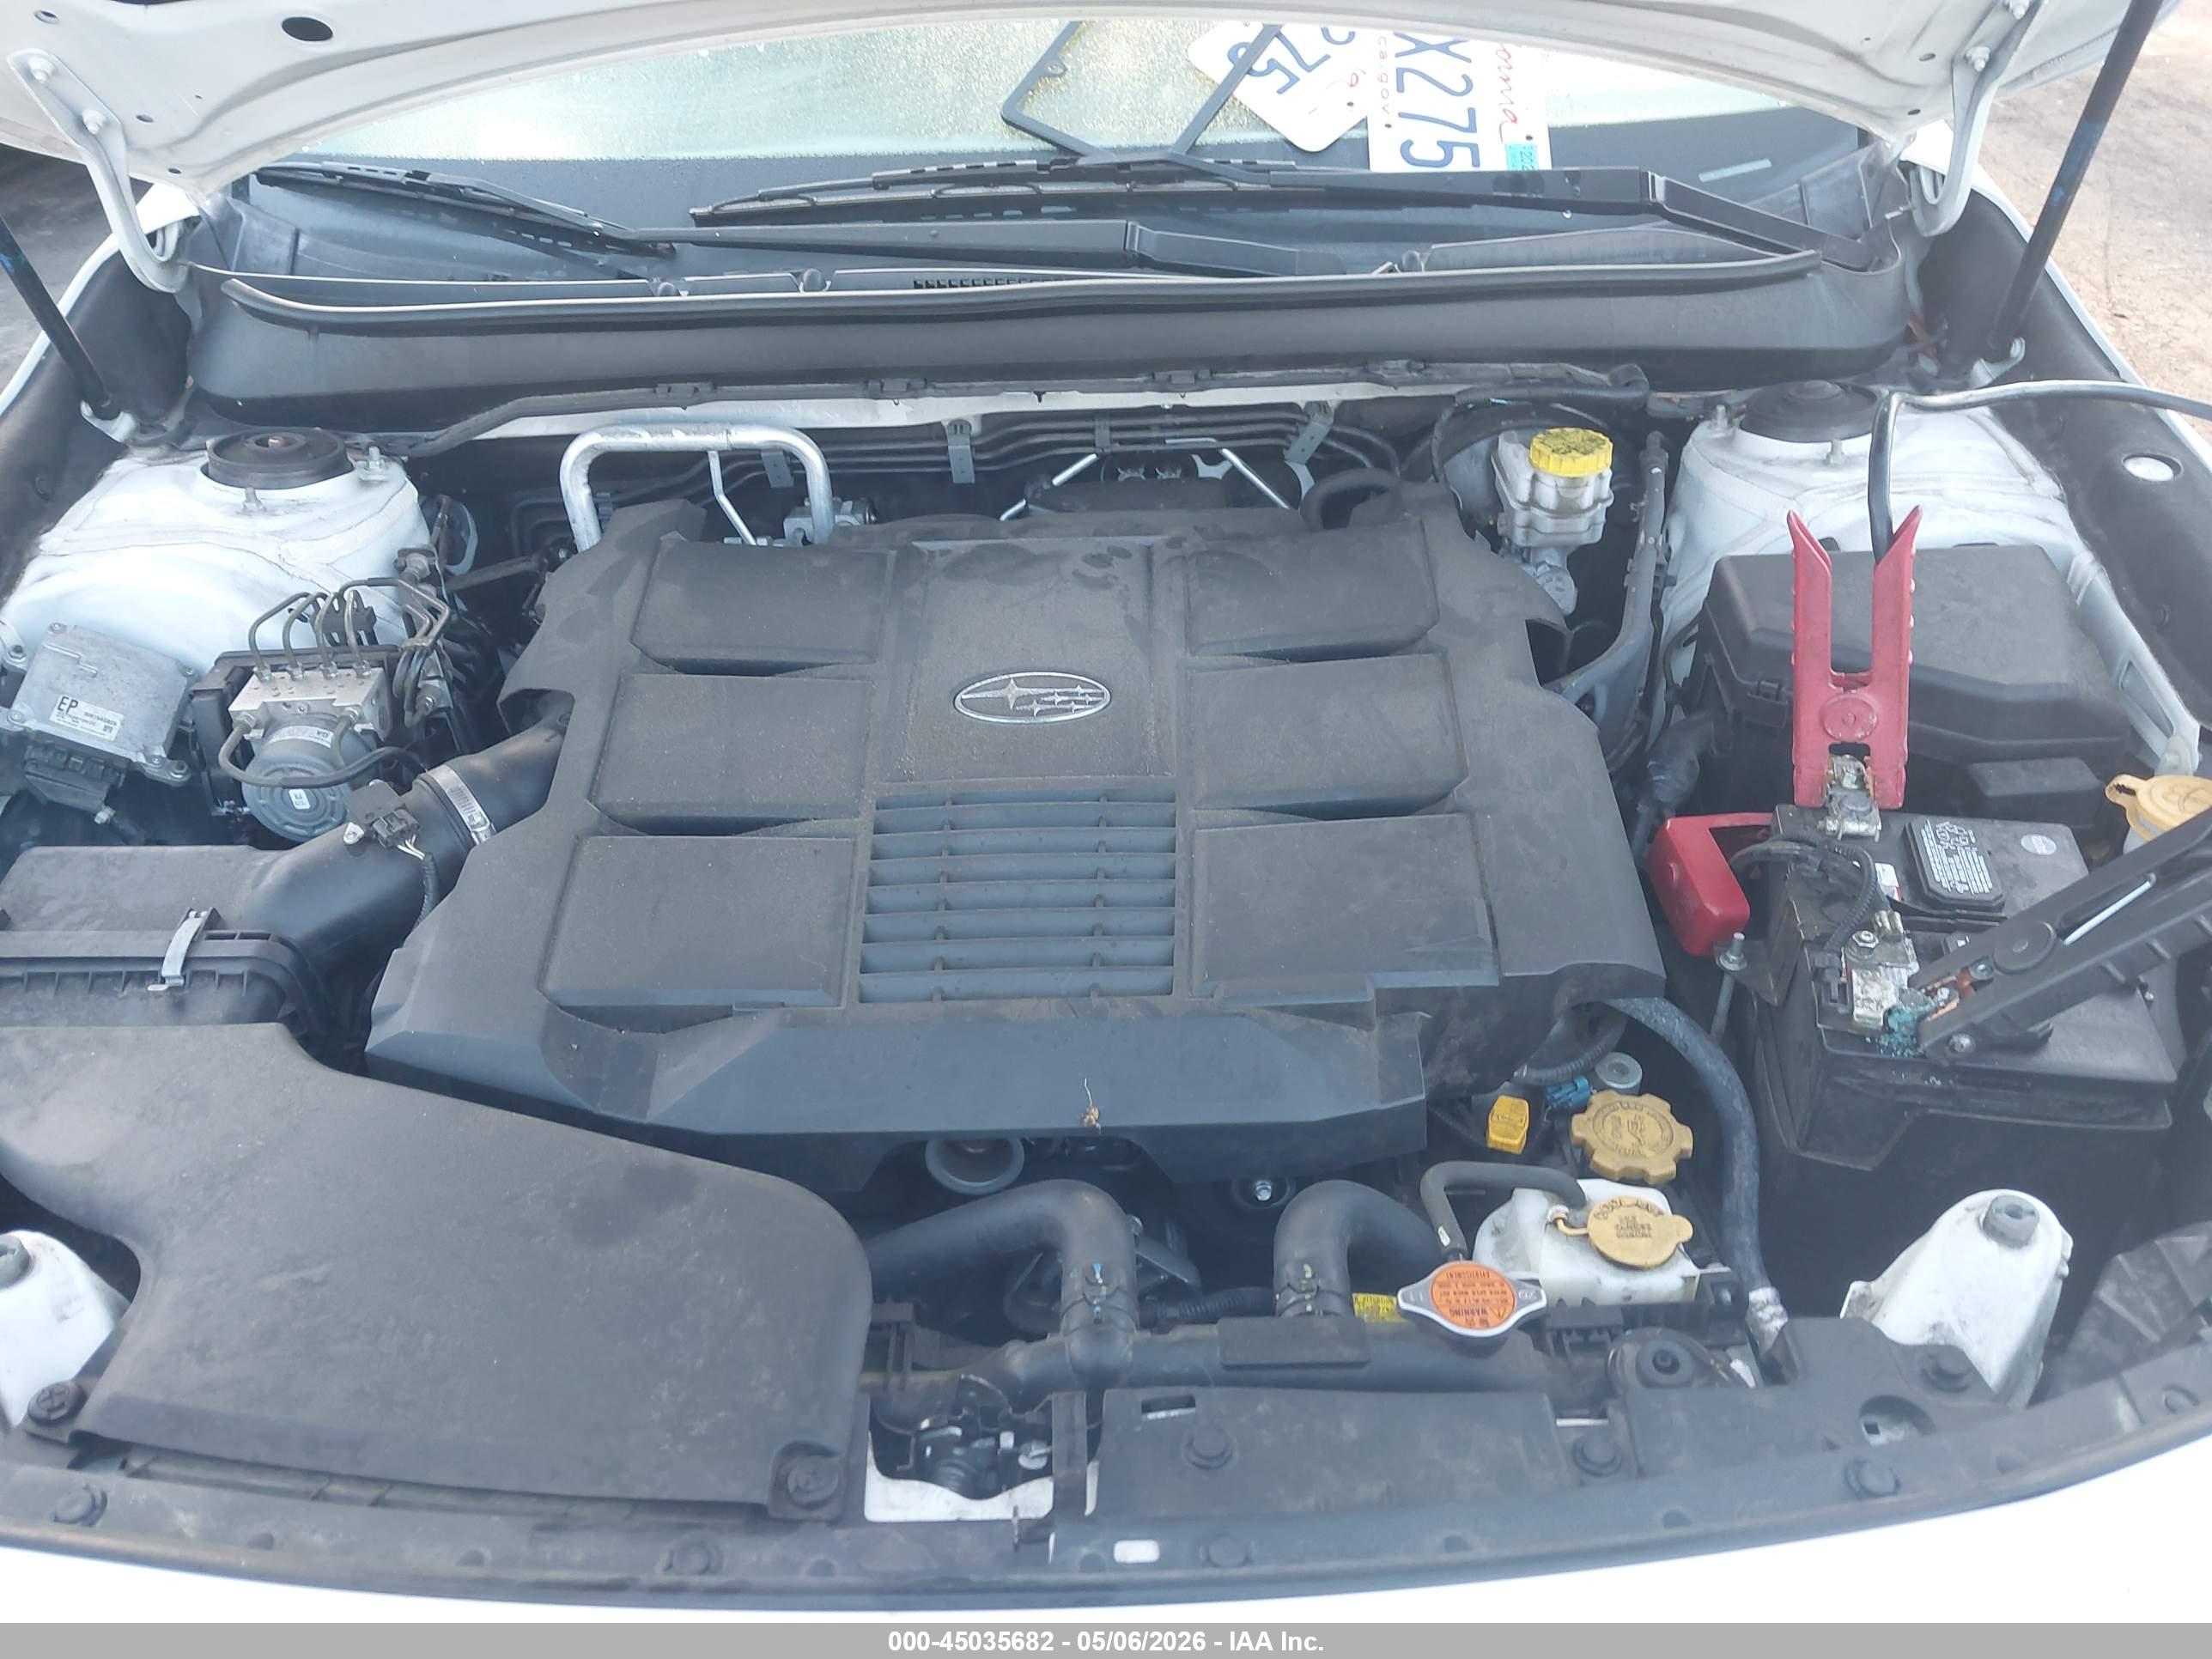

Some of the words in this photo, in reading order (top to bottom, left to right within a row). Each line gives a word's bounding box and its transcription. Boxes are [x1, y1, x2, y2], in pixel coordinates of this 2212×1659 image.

[1394, 32, 1481, 169] X275
[57, 696, 78, 714] EP
[1449, 1307, 1488, 1318] WARNING
